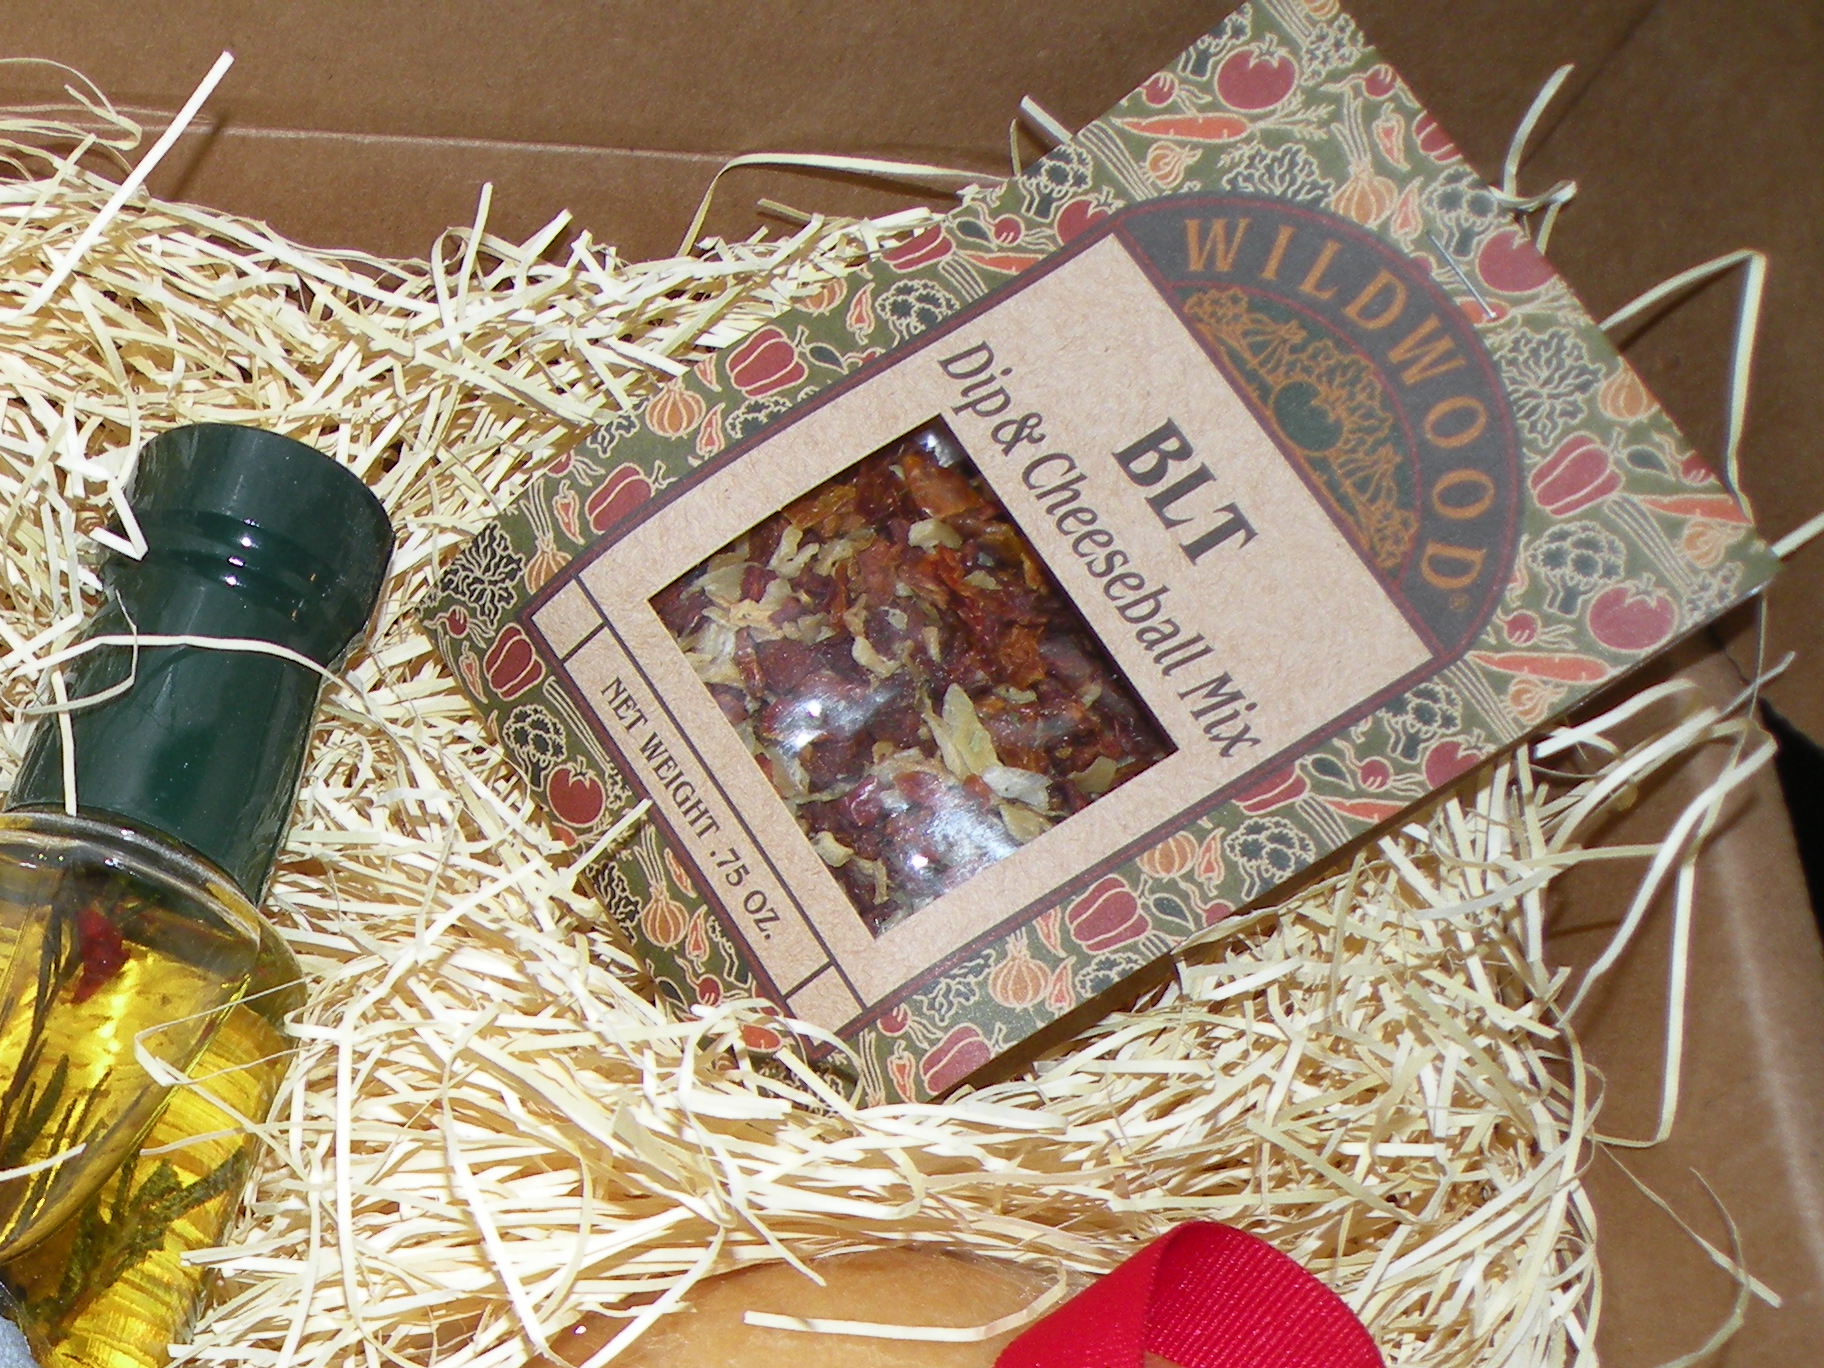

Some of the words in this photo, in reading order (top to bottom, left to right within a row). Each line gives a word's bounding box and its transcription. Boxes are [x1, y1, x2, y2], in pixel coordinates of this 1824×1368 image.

[938, 340, 1014, 417] Dip
[1021, 451, 1216, 678] Cheeseball
[1177, 671, 1262, 759] Mix
[1111, 416, 1258, 566] BLT
[1183, 217, 1495, 590] WILDWOOD
[601, 676, 649, 732] NET
[639, 731, 721, 839] WEIGHT
[709, 847, 751, 888] .75
[743, 889, 782, 941] OZ.
